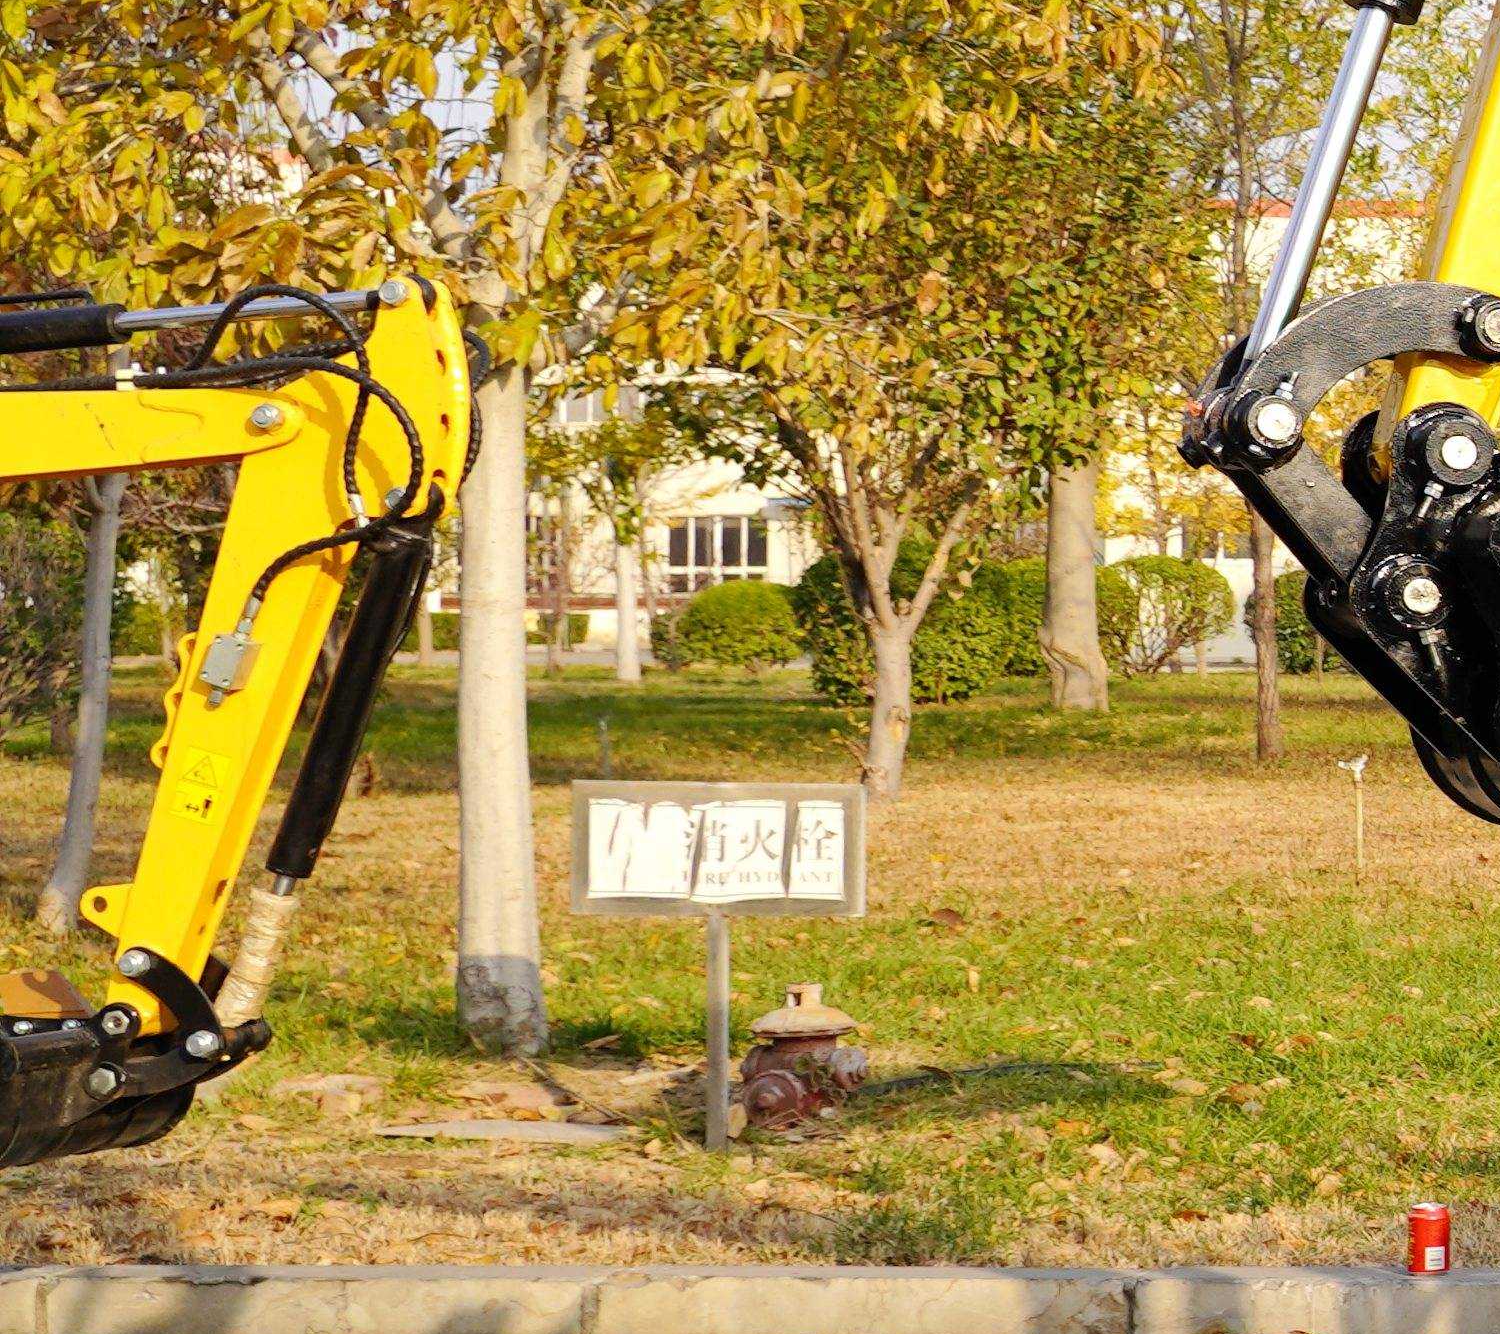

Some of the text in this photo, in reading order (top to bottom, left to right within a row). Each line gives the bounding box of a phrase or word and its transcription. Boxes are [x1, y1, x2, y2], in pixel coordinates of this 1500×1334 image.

[683, 820, 839, 863] 消火栓
[738, 870, 834, 883] HYDANT
